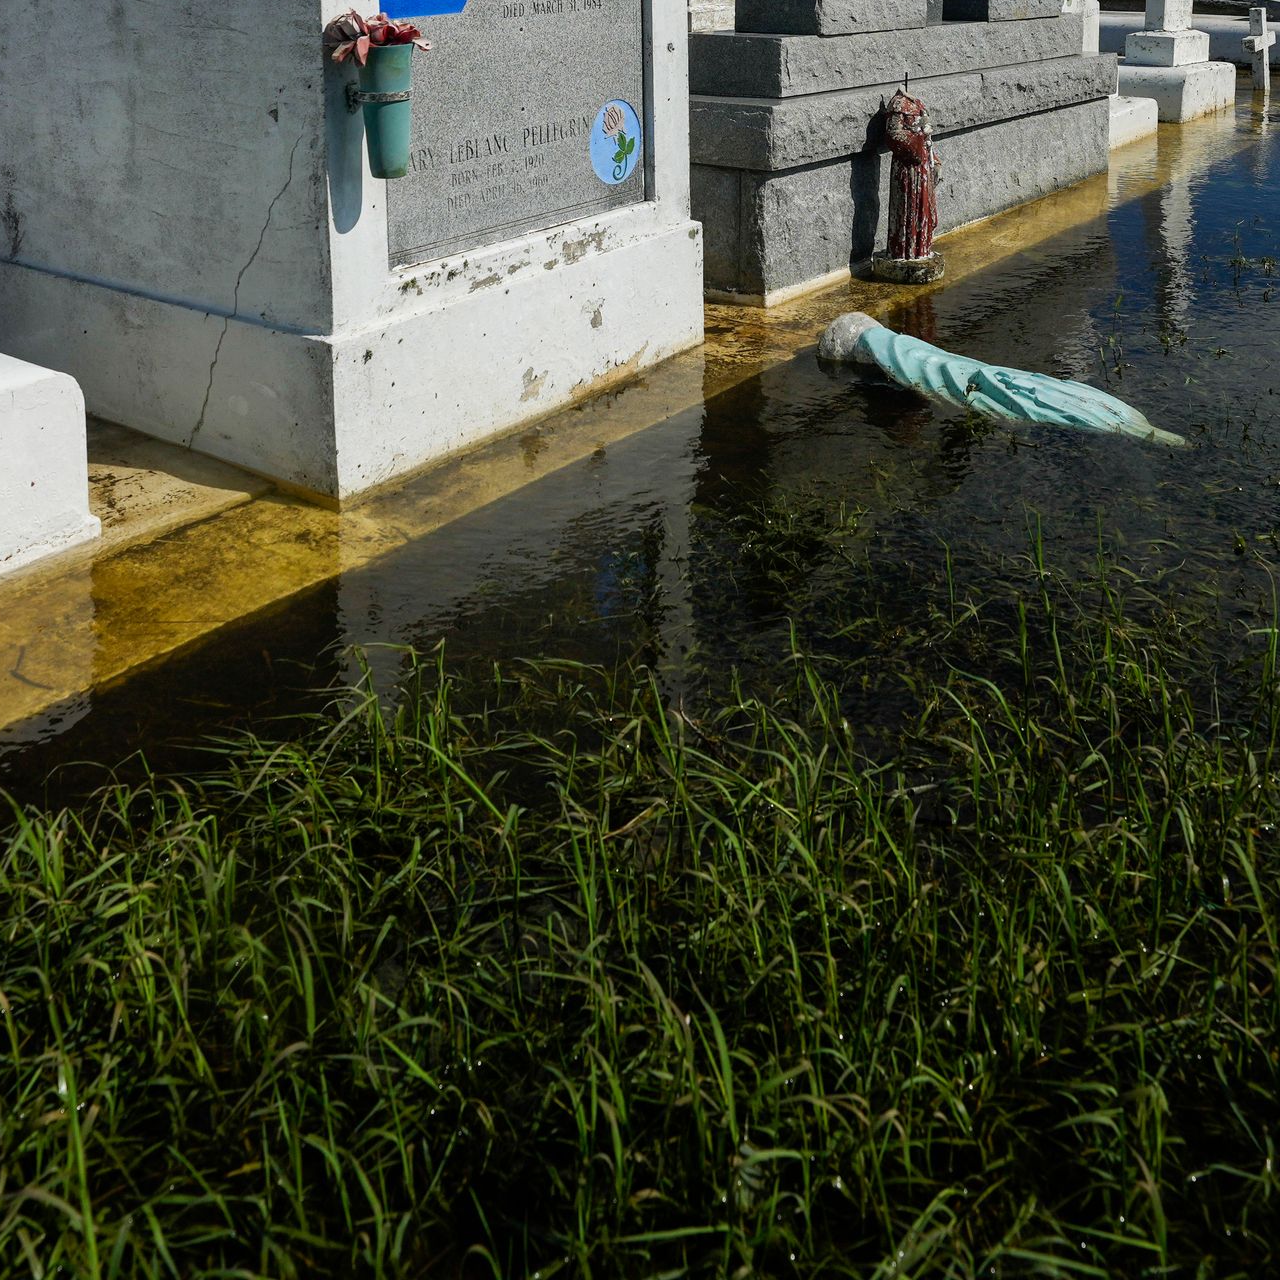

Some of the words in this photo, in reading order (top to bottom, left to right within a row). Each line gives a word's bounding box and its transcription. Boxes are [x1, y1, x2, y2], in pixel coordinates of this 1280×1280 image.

[502, 2, 525, 19] DIED
[533, 0, 563, 15] MARCH
[409, 147, 434, 172] ARY
[523, 115, 591, 148] PELLEGRIN
[451, 169, 478, 187] BORN
[447, 193, 471, 211] DIED
